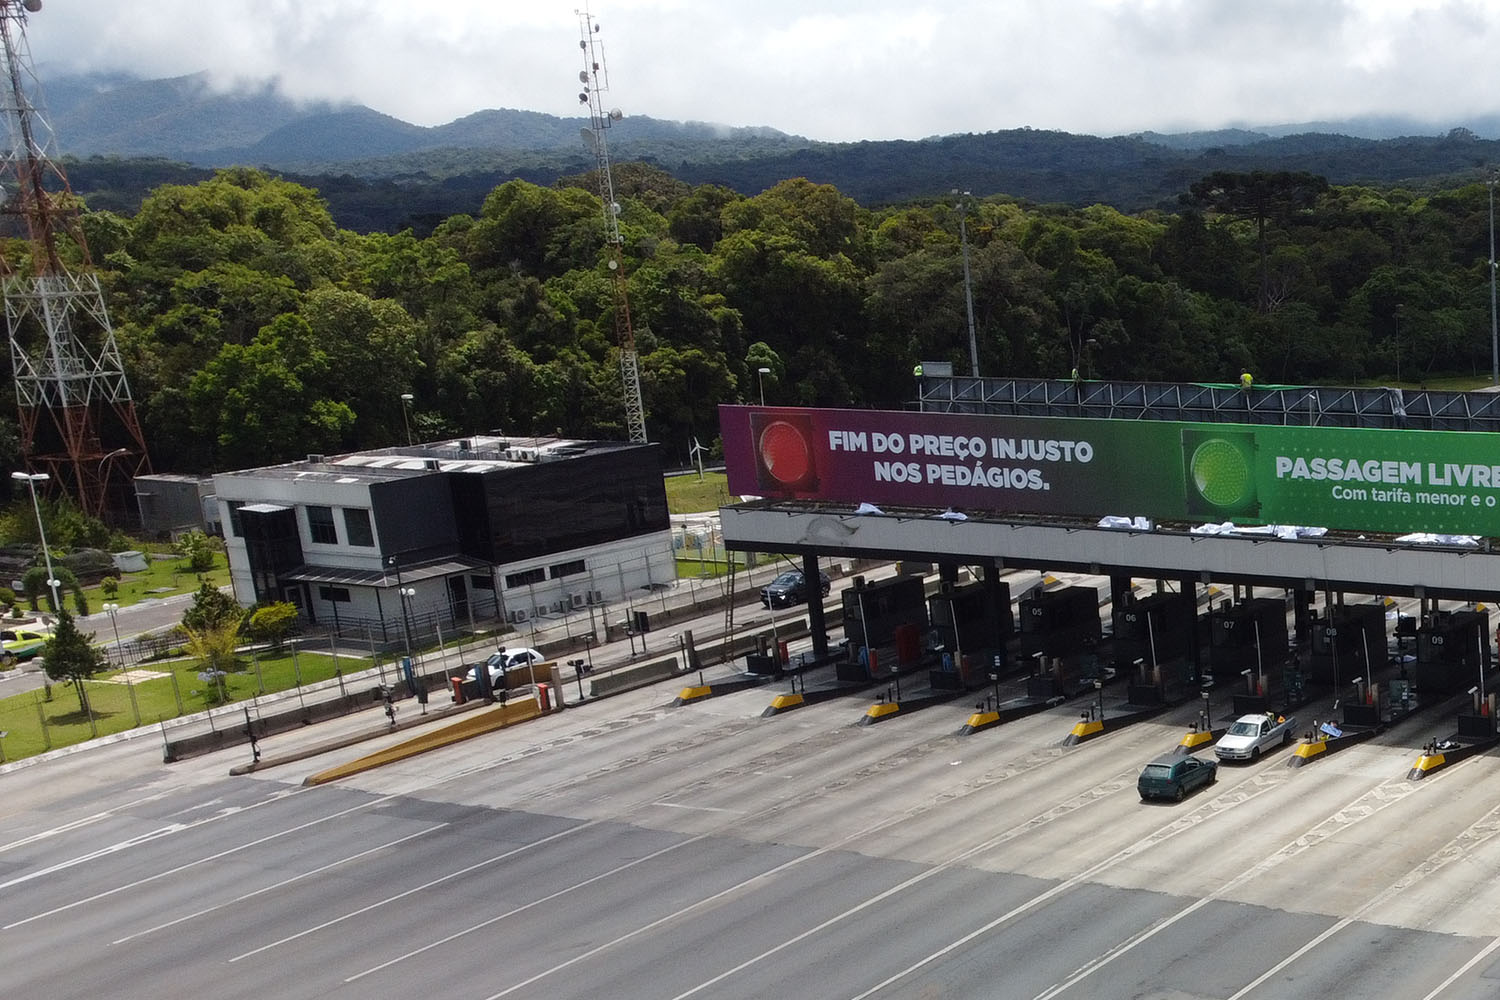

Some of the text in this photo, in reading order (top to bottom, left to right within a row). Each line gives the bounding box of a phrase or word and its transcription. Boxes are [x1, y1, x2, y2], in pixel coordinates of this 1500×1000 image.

[828, 430, 1093, 463] FIM DO PREÇO INJUSTO
[874, 460, 1050, 490] NOS PEDÁGIOS.
[1276, 456, 1422, 485] PASSAGEM
[1332, 485, 1367, 501] Com
[1371, 487, 1411, 503] tarifa
[1416, 491, 1466, 506] menor
[1471, 494, 1481, 507] e
[1485, 495, 1496, 508] o
[1032, 607, 1042, 616] 05
[1125, 614, 1137, 622] 06
[1223, 620, 1235, 629] 07
[1431, 635, 1444, 645] 09
